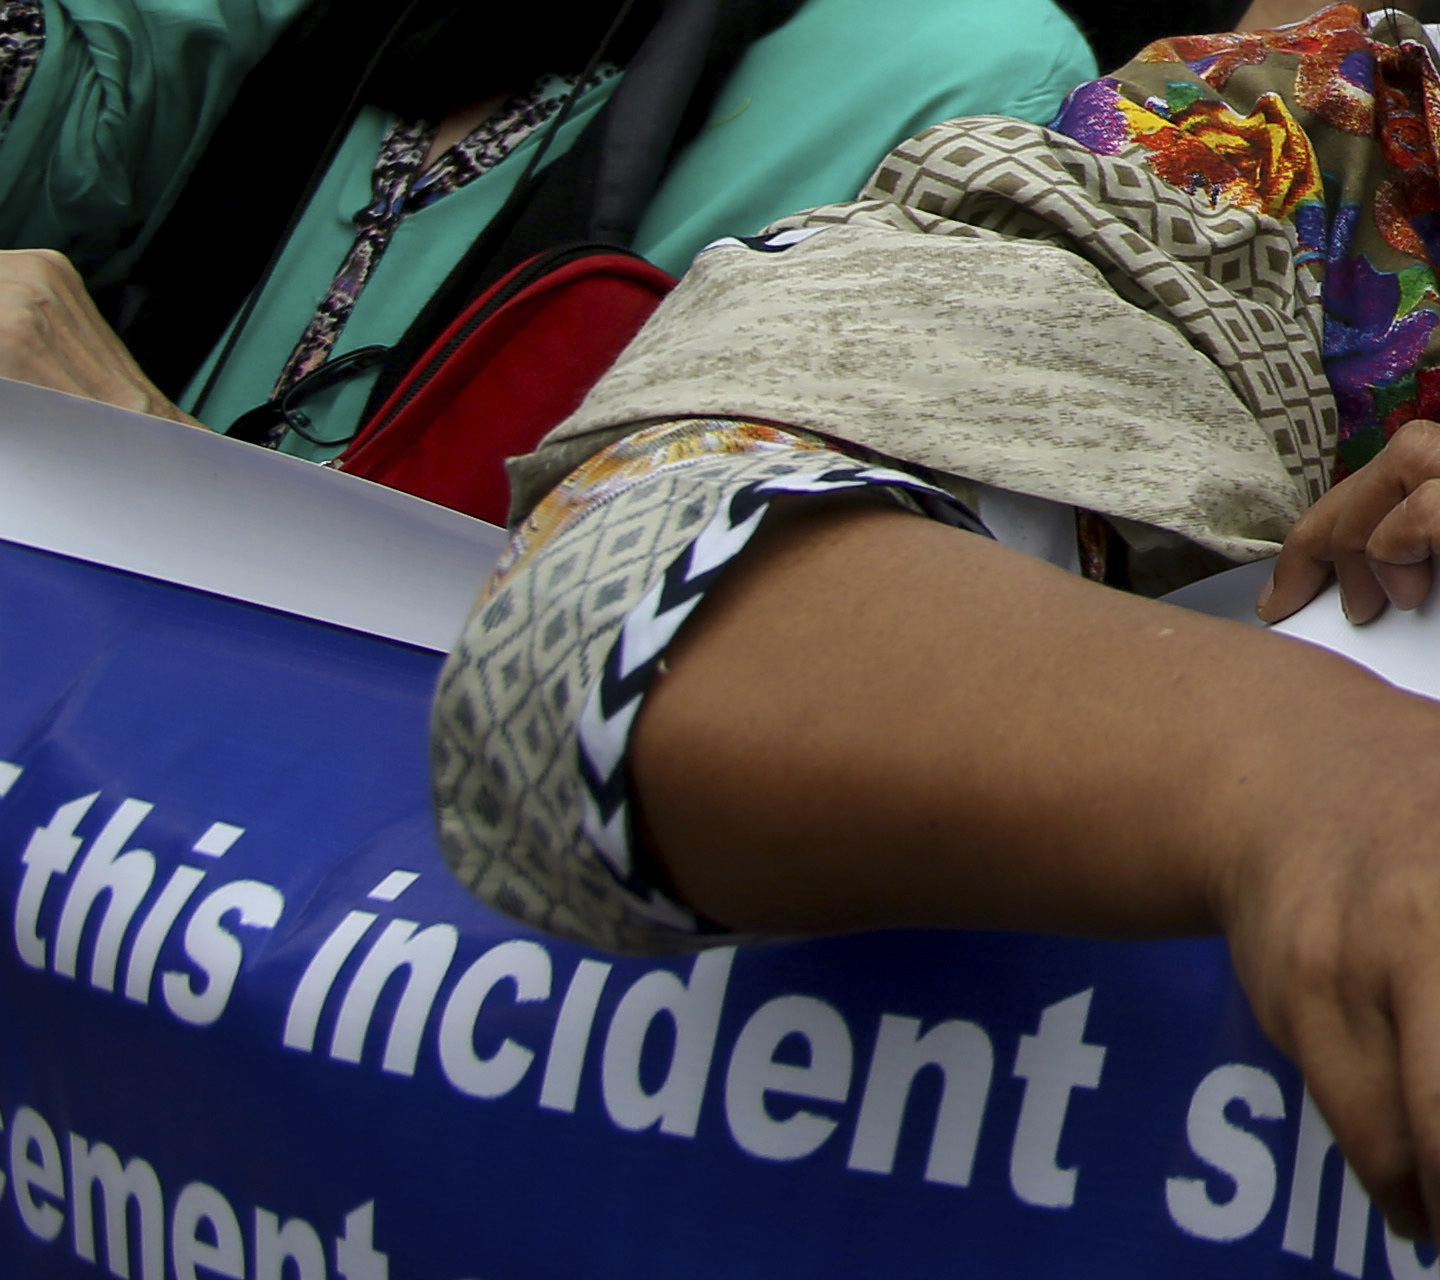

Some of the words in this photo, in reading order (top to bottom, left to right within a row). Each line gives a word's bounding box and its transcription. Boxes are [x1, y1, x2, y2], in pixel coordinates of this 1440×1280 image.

[14, 791, 285, 1026] this
[283, 869, 1107, 1210] incident
[0, 1104, 391, 1280] ement
